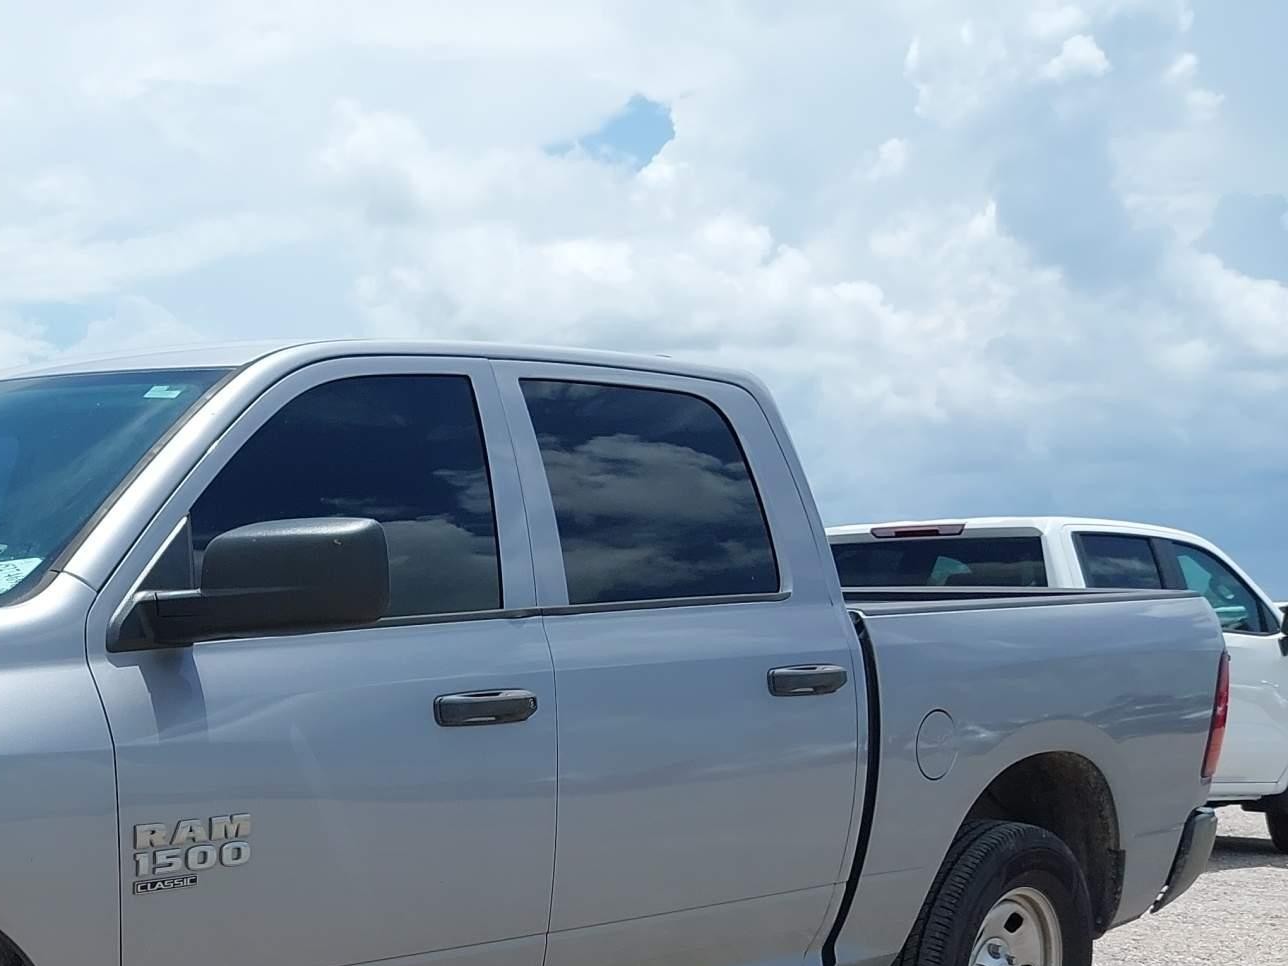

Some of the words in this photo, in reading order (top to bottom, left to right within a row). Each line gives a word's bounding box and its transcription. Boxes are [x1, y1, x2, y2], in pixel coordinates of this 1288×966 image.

[133, 812, 250, 849] RAM
[134, 840, 250, 876] 1500
[135, 875, 198, 894] CLASSIC
